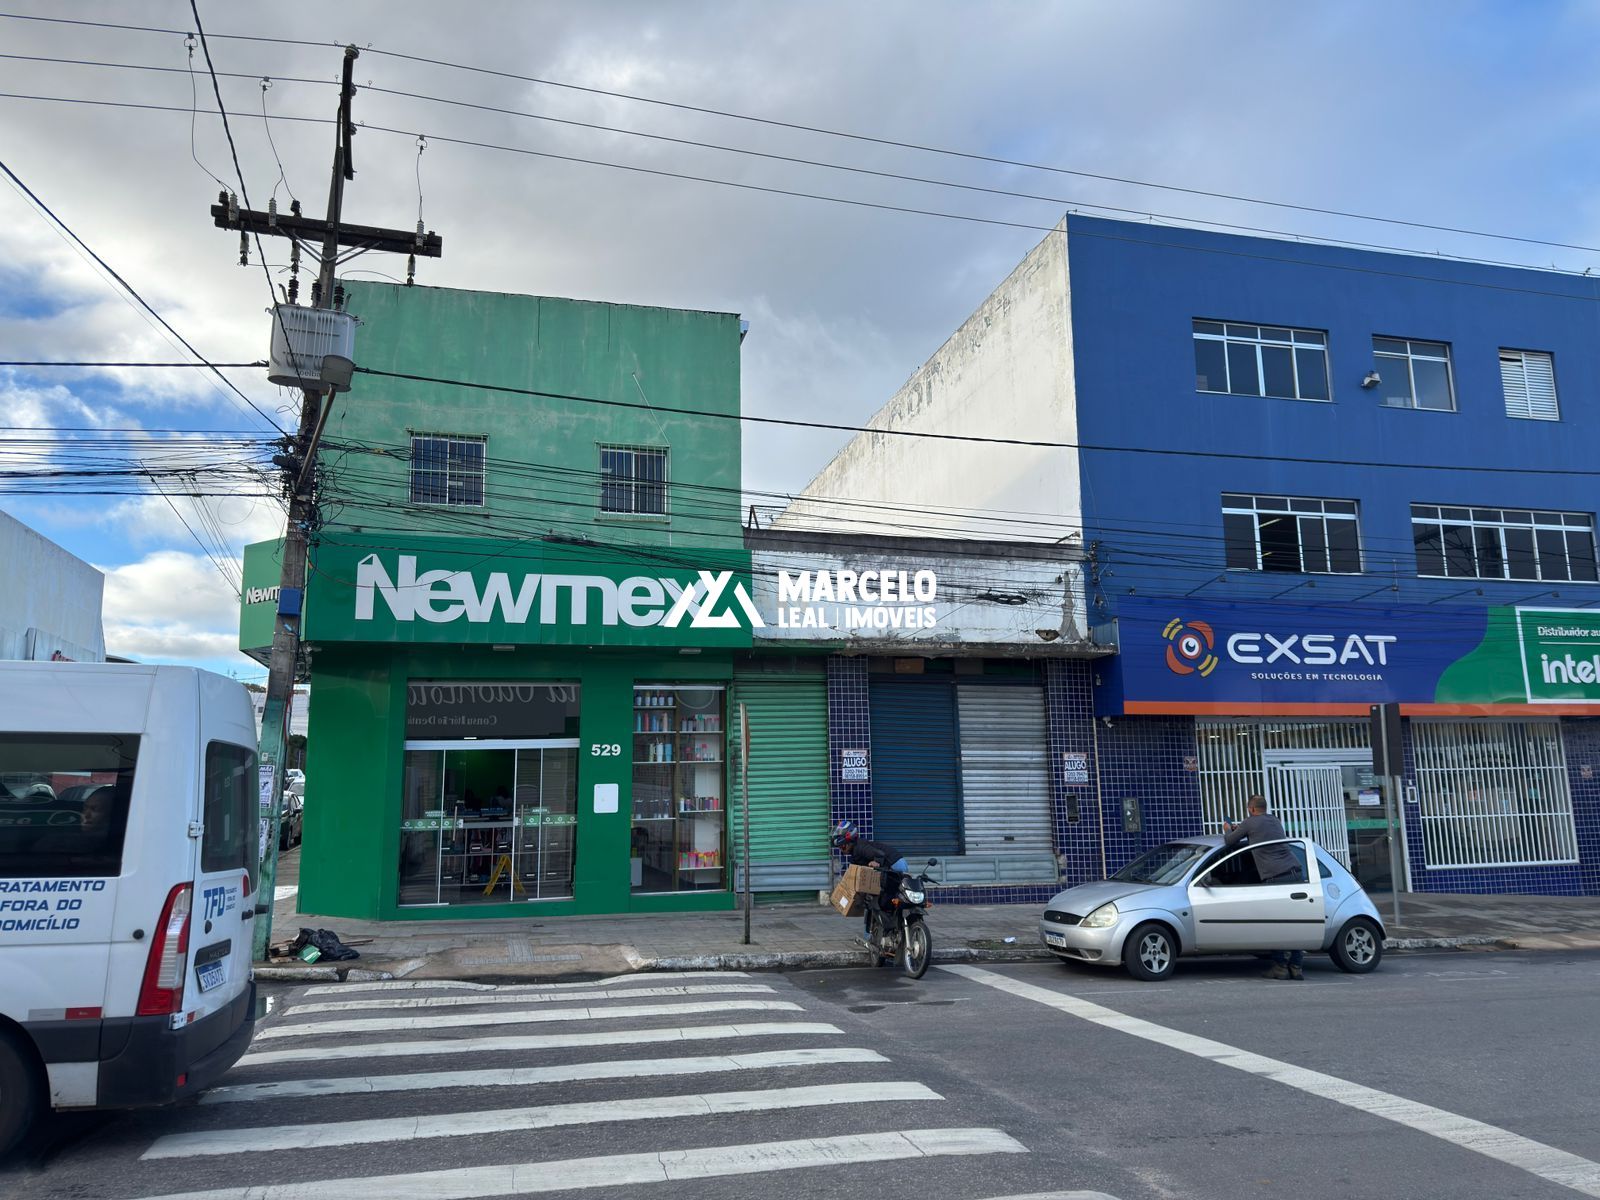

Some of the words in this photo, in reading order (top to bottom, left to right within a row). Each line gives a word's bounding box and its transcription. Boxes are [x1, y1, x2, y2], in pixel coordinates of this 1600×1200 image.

[1537, 626, 1589, 637] Distribuidor
[1227, 633, 1397, 666] EXSAT
[1251, 672, 1303, 681] SOLUÇÕES
[1323, 673, 1383, 681] TECNOLOGIA
[591, 743, 621, 757] 529
[843, 757, 867, 767] ALUGO
[1064, 760, 1087, 770] ALUGO
[0, 899, 49, 911] FORA
[56, 899, 82, 910] DO
[204, 886, 226, 920] TFD
[0, 915, 80, 931] OMICÍLIO
